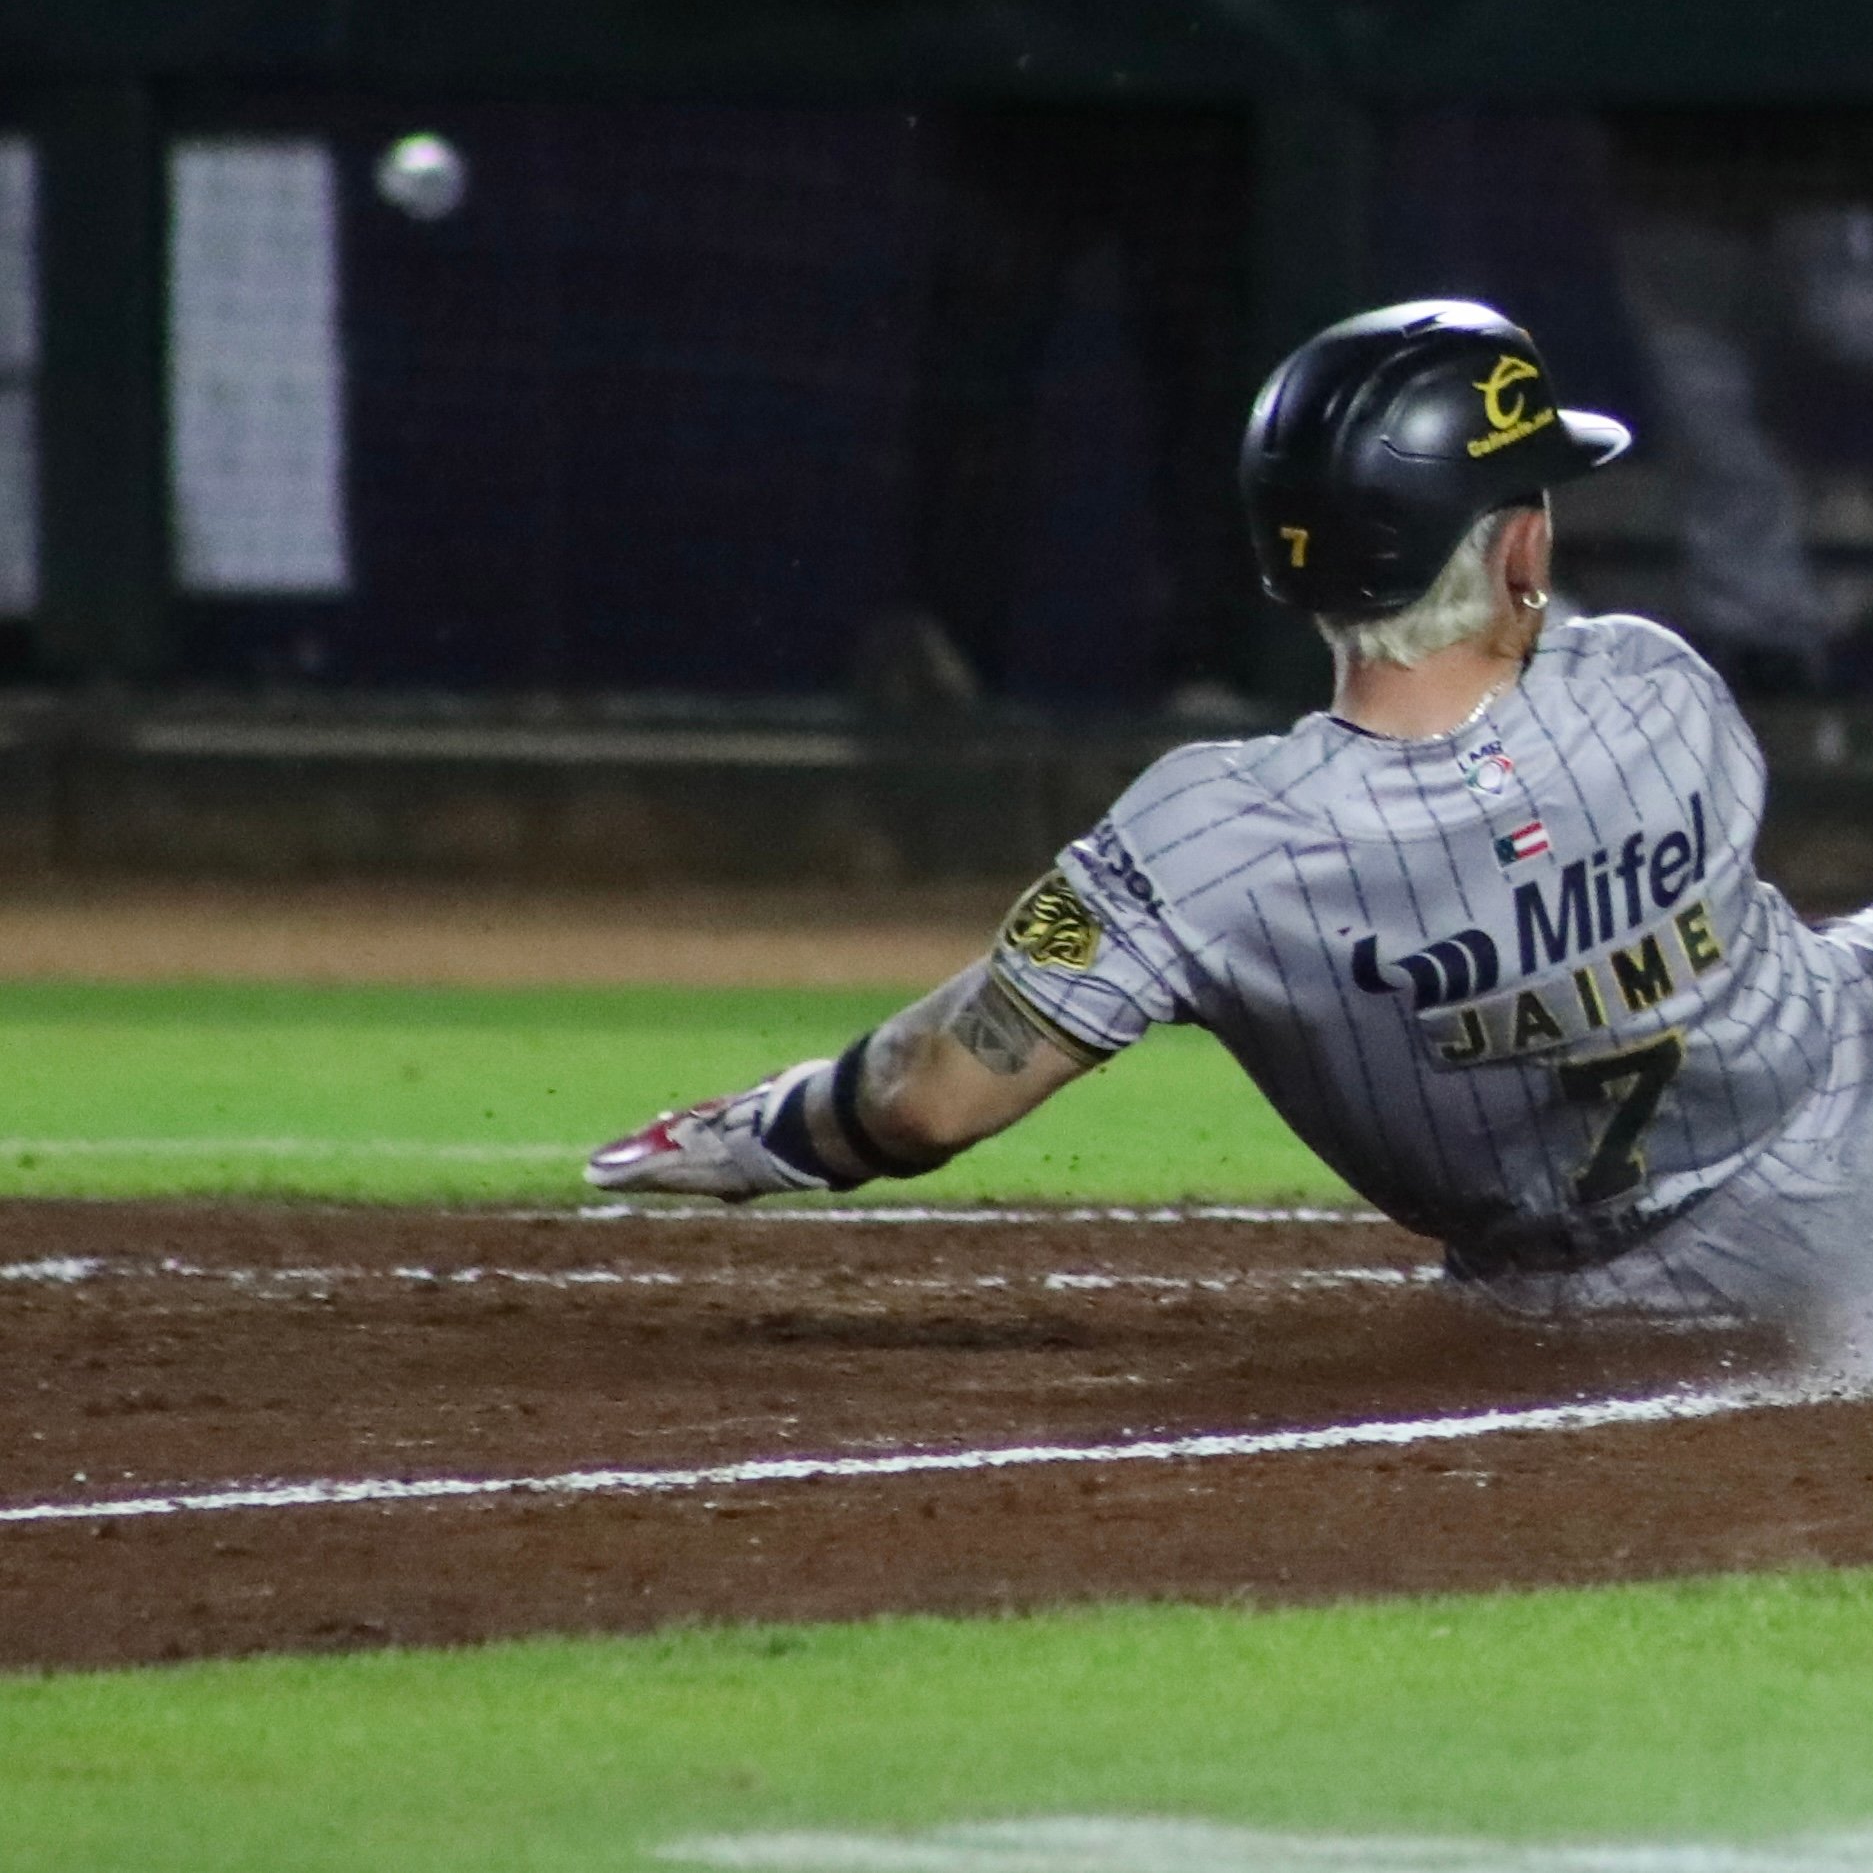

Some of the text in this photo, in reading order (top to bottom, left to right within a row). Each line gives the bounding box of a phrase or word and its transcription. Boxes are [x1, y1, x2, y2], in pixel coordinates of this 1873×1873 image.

[1281, 527, 1308, 567] 7
[1514, 791, 1706, 977] Mifel
[1440, 901, 1722, 1063] JAIME
[1557, 1025, 1687, 1205] 7
